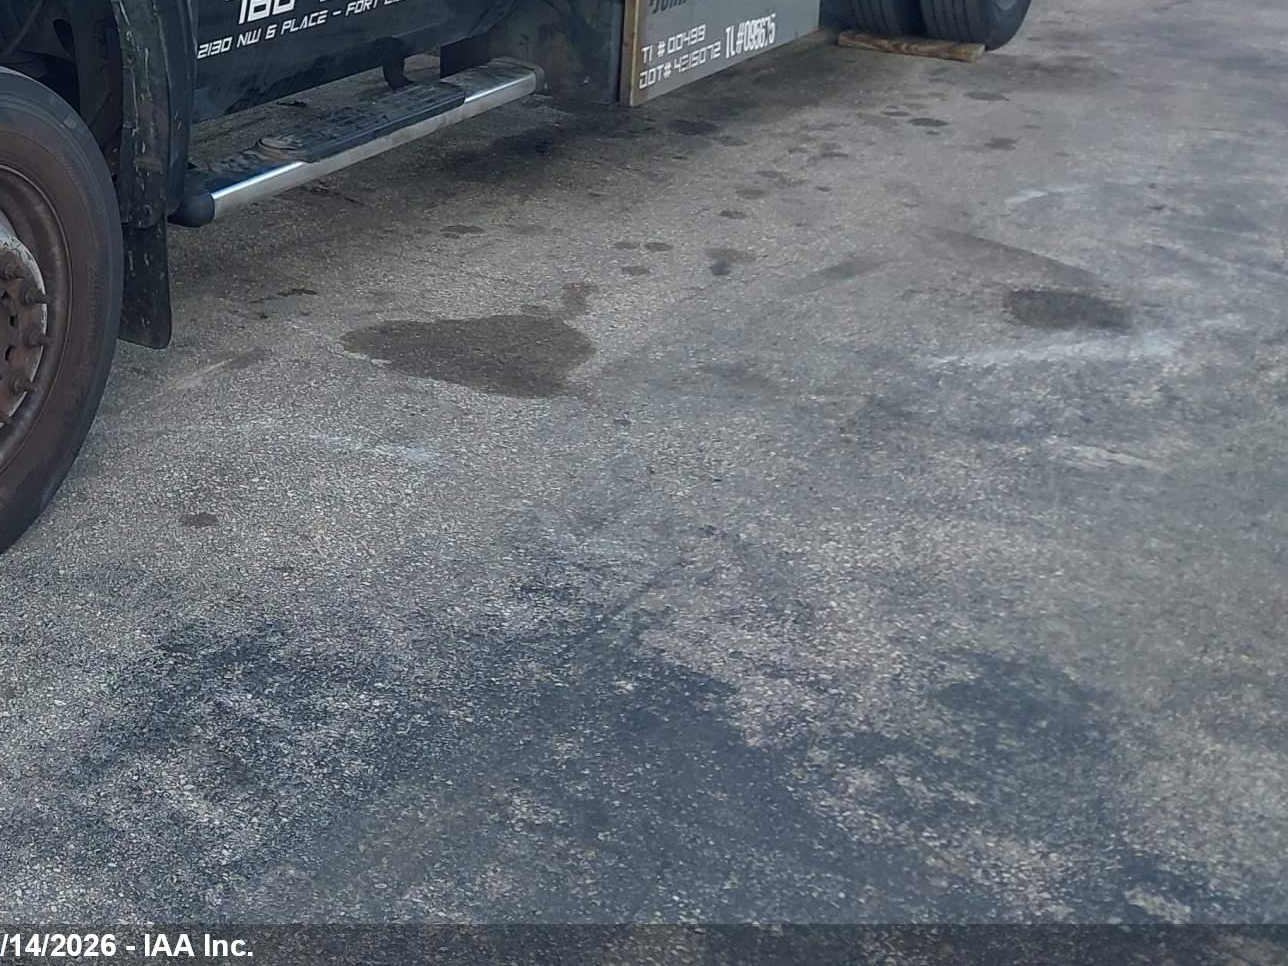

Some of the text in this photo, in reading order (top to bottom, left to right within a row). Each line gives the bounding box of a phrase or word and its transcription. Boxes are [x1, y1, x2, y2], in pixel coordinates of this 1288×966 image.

[197, 37, 233, 60] 2130
[236, 28, 262, 48] NW
[265, 24, 278, 40] 6
[281, 9, 329, 35] PLACE
